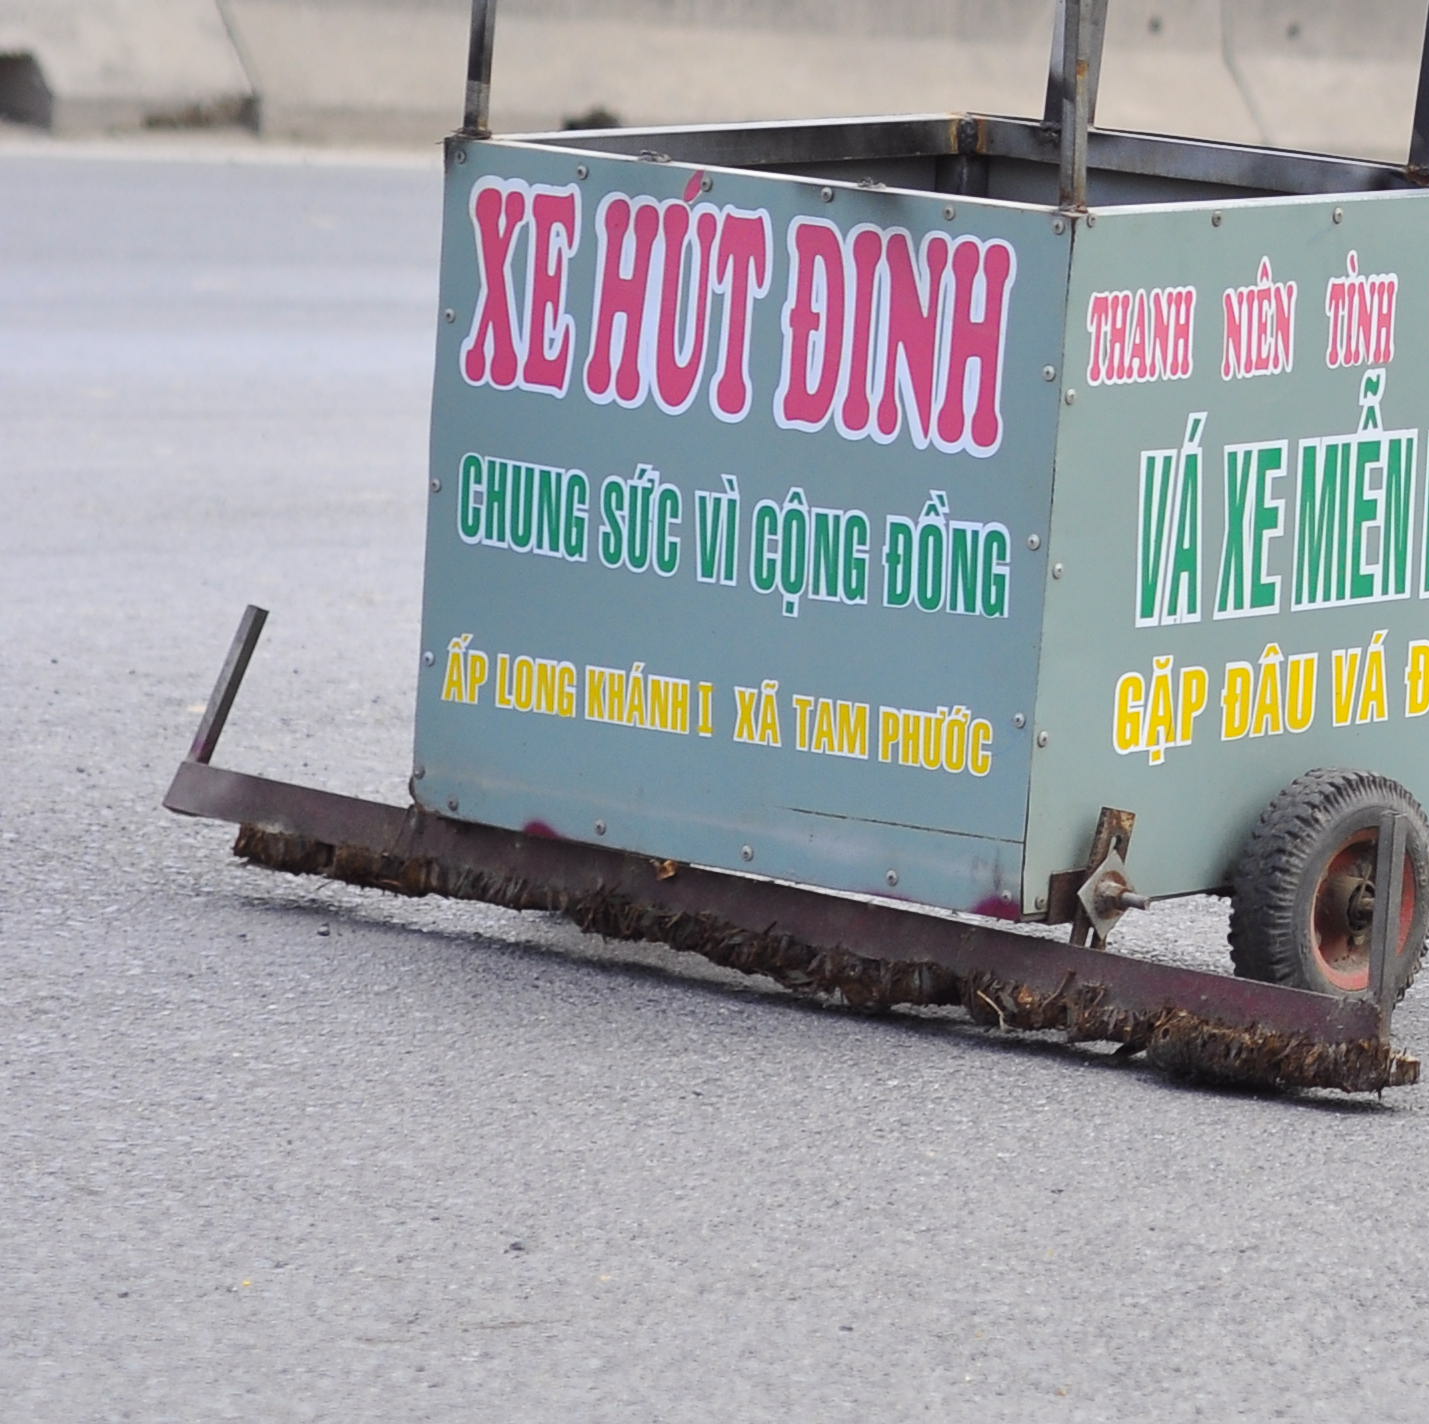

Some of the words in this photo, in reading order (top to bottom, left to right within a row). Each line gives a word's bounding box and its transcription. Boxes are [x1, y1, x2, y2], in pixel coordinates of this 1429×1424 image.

[465, 187, 577, 389] XE
[586, 169, 768, 414] HÚT
[782, 222, 1012, 448] ĐINH
[1089, 289, 1194, 382] THANH
[1223, 261, 1295, 378] NIÊN
[1328, 253, 1397, 366] TÌNH
[459, 454, 588, 557] CHUNG
[601, 467, 681, 573] SỨC
[697, 477, 738, 580] VÌ
[753, 490, 869, 614] CỘNG
[885, 494, 1008, 618] ĐỒNG
[1140, 419, 1201, 619] VÁ
[1218, 446, 1283, 612] XE
[1294, 374, 1414, 605] MIỄN
[443, 637, 488, 703] ẤP
[497, 656, 576, 718] LONG
[587, 664, 690, 733] KHÁNH
[697, 683, 715, 735] I
[736, 682, 780, 745] XÃ
[794, 697, 869, 756] TAM
[880, 707, 992, 775] PHƯỚC
[1115, 657, 1208, 762] GẶP
[1222, 644, 1317, 739] ĐÂU
[1333, 632, 1387, 725] VÁ
